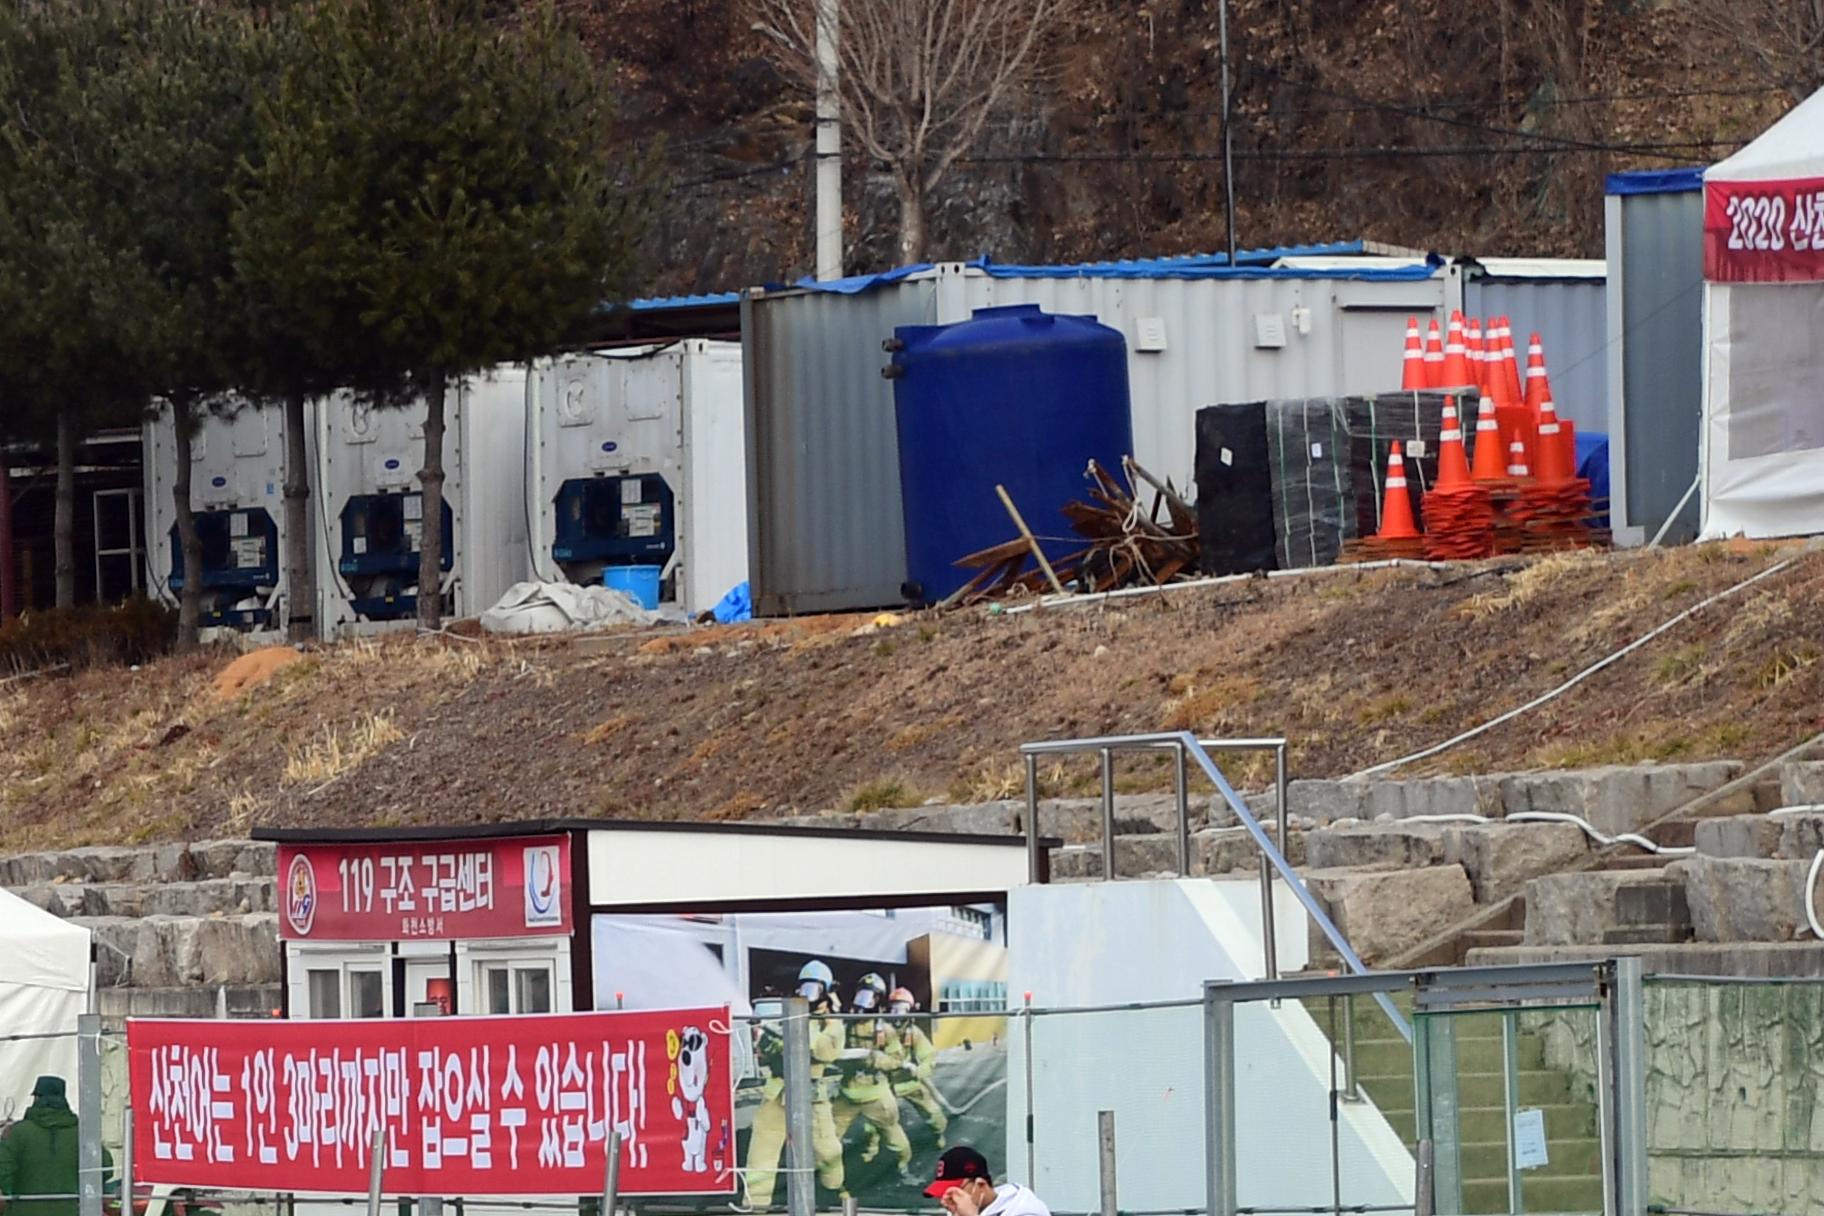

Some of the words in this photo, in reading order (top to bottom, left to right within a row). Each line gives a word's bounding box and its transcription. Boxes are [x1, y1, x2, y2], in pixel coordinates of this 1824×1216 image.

[1727, 196, 1786, 251] 2020
[339, 858, 373, 913] 119
[380, 856, 416, 914] 구조
[421, 852, 495, 913] 구급센터
[401, 917, 444, 936] 화천소방서
[149, 1044, 234, 1164] 산천어는
[242, 1047, 278, 1165] 1인
[282, 1044, 410, 1170] 3마리까지만
[417, 1044, 493, 1170] 잡으실
[500, 1044, 527, 1170] 수
[535, 1039, 647, 1170] 있습니다!
